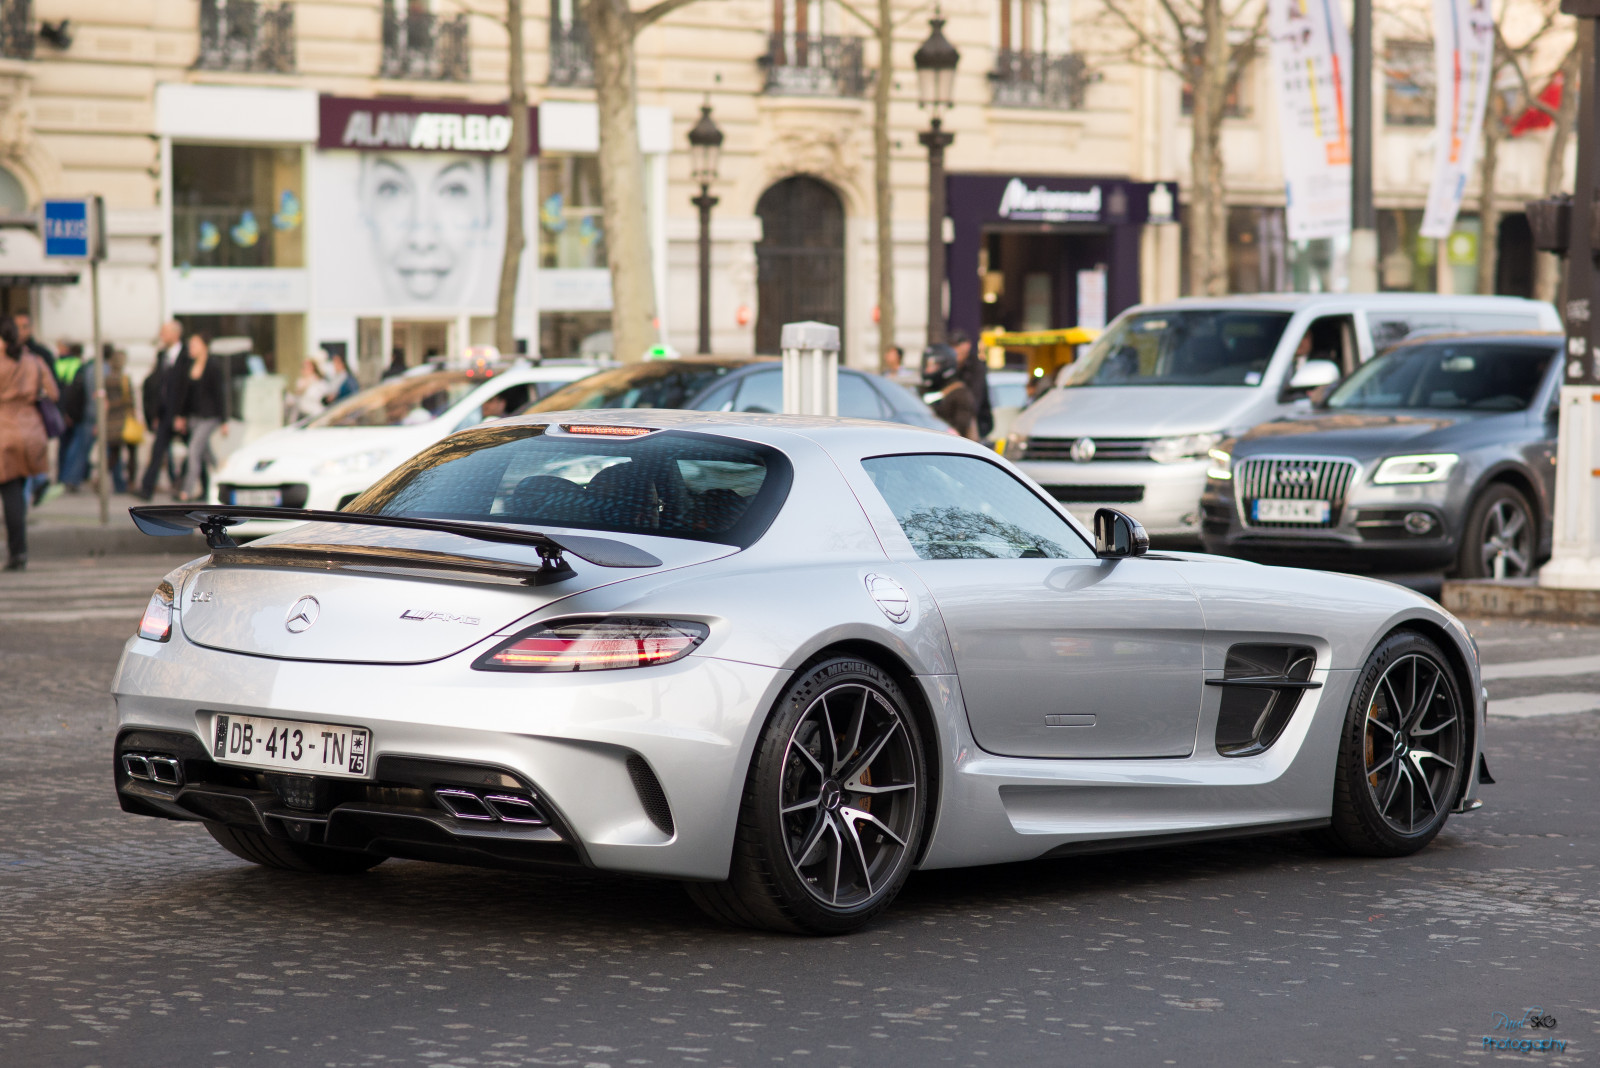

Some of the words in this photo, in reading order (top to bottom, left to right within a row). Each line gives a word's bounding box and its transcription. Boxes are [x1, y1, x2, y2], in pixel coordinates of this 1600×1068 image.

[46, 217, 87, 239] TAXIS
[827, 661, 879, 680] MICHELIN
[217, 741, 223, 750] F
[230, 722, 346, 765] DB-413-TN
[350, 755, 364, 770] 75
